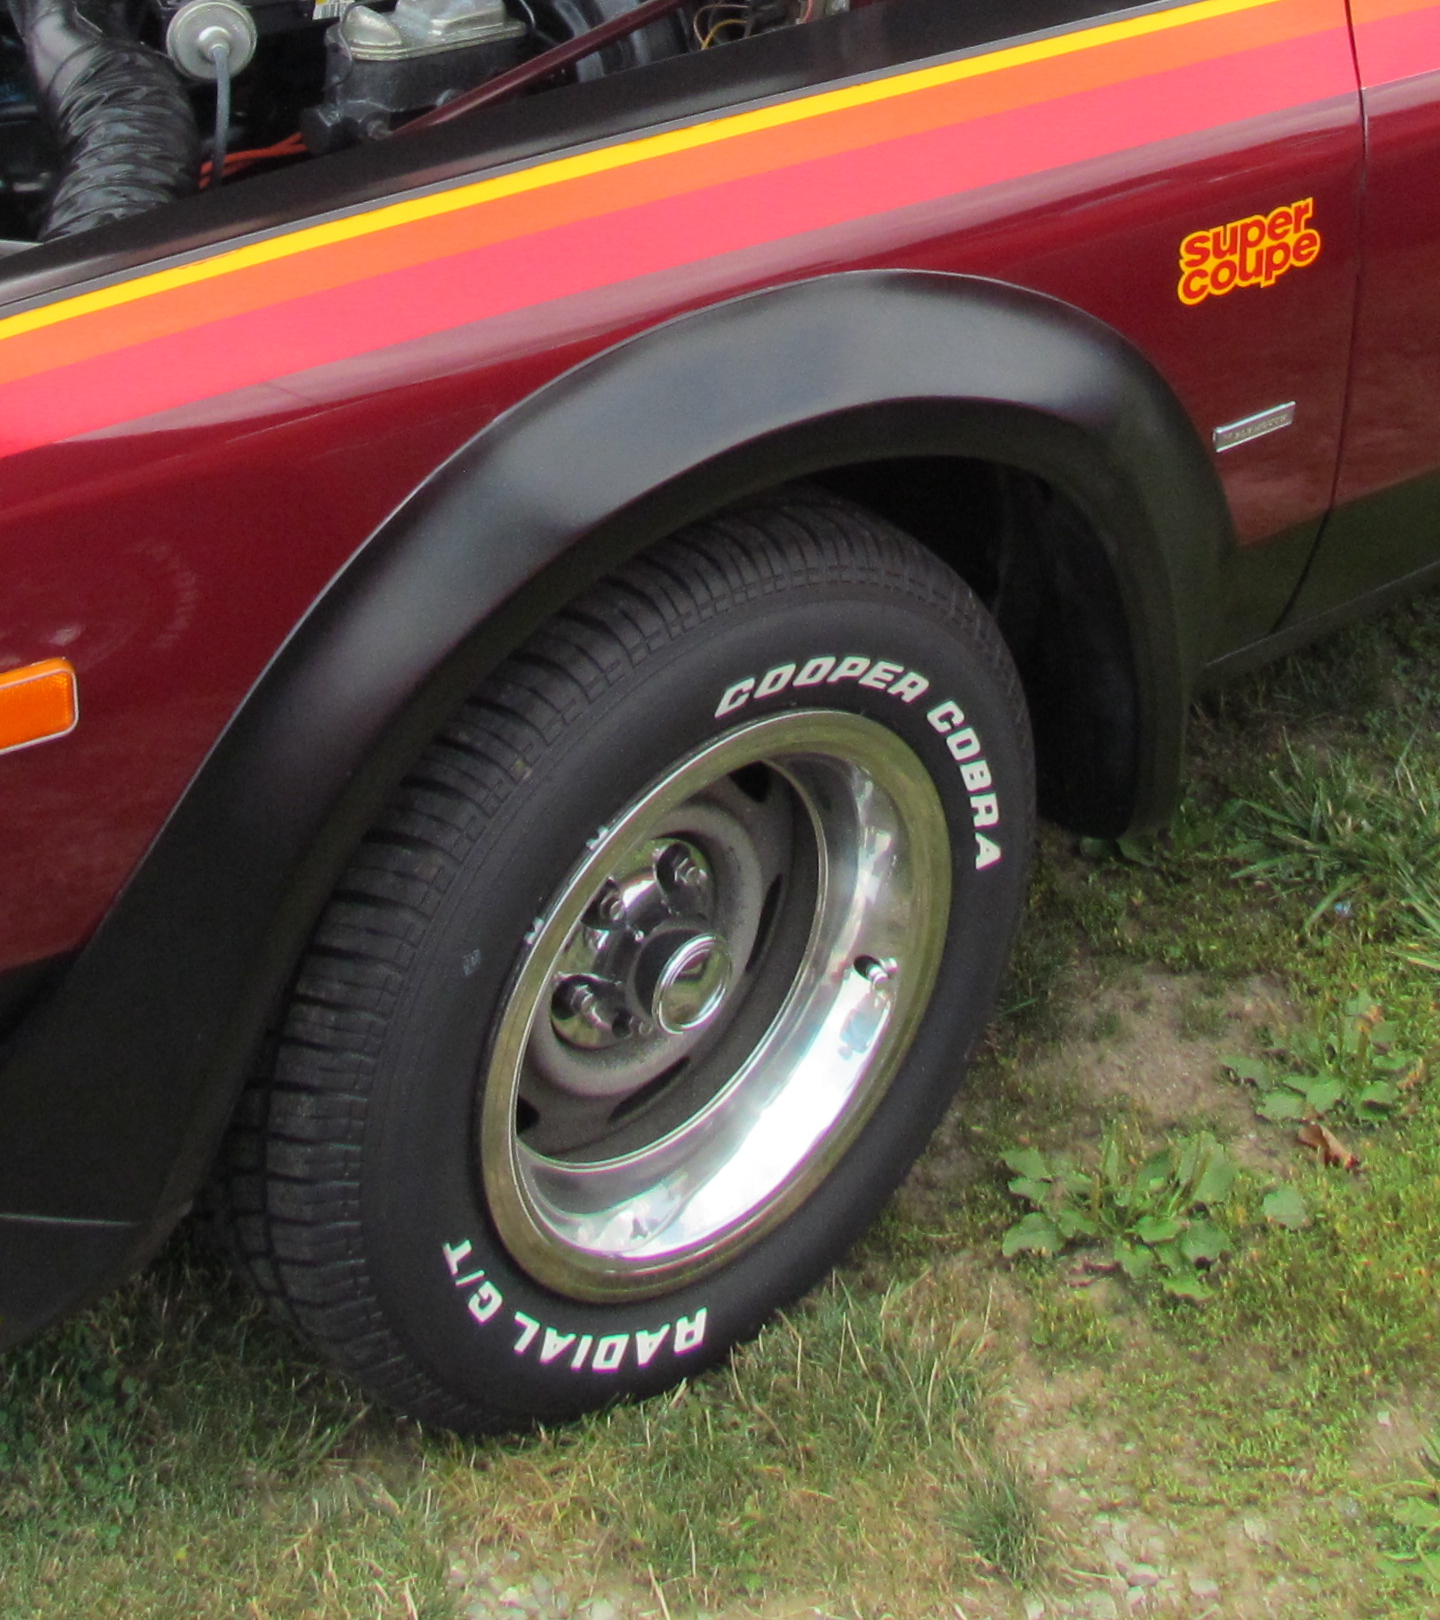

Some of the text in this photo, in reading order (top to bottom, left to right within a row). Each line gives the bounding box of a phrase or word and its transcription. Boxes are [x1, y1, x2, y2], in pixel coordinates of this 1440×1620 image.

[1177, 226, 1322, 306] coupe
[1180, 196, 1314, 269] super
[714, 655, 1003, 870] COOPER COBRA
[442, 1238, 708, 1374] RADIAL G/T
